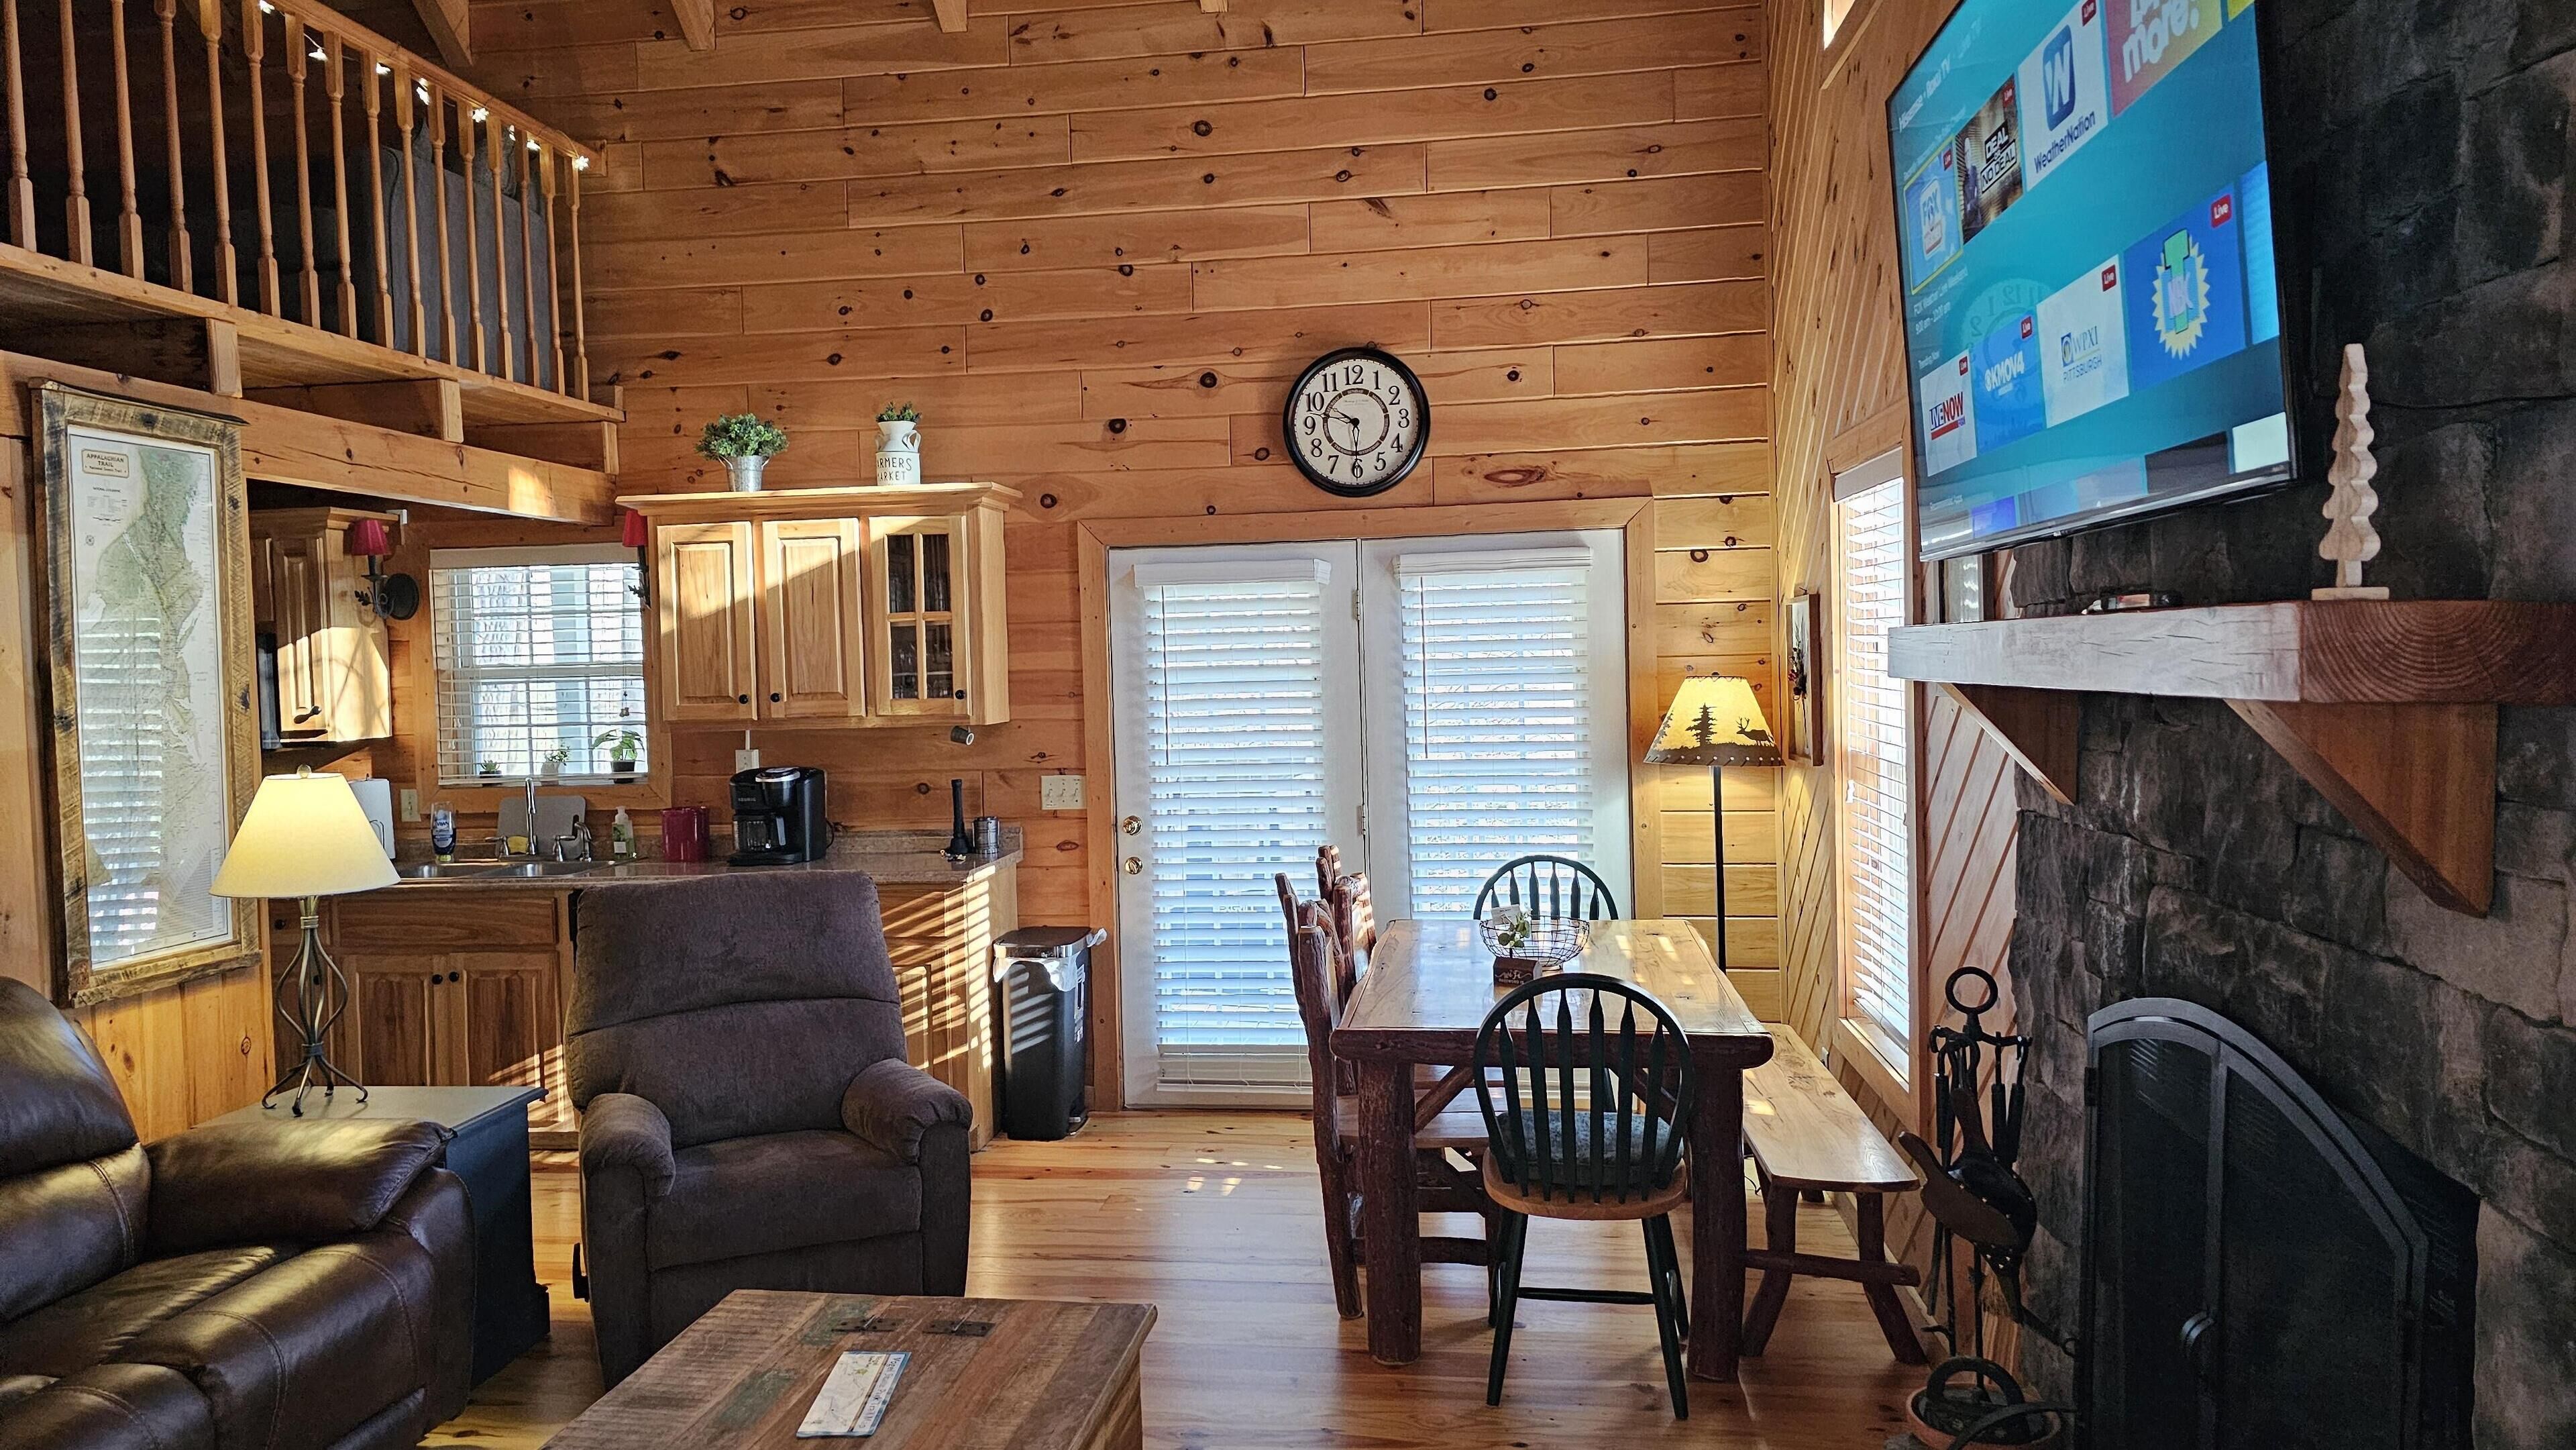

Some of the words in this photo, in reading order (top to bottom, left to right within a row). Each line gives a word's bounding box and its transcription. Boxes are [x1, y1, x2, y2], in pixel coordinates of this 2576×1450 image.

[2084, 0, 2095, 14] Live
[1941, 53, 1951, 79] TV
[2045, 41, 2070, 115] W
[1986, 127, 2008, 159] DEAL
[2034, 111, 2096, 174] WeatherNation
[1982, 165, 1994, 186] NO
[1995, 146, 2016, 176] DEAL
[2213, 203, 2229, 219] Live
[2103, 271, 2114, 284] Live
[2073, 325, 2099, 354] WPXI
[1344, 364, 1364, 385] 12
[2063, 354, 2102, 384] PITTSBURGH
[1322, 372, 1339, 393] 11
[1373, 370, 1381, 390] 1
[1306, 391, 1325, 412] 10
[1389, 385, 1401, 405] 2
[1304, 415, 1316, 435] 9
[1398, 408, 1409, 428] 3
[1311, 438, 1323, 458] 8
[1391, 433, 1403, 453] 4
[87, 453, 123, 463] APPALACHIAN
[1328, 455, 1339, 474] 7
[1352, 458, 1363, 478] 6
[1374, 452, 1386, 471] 5
